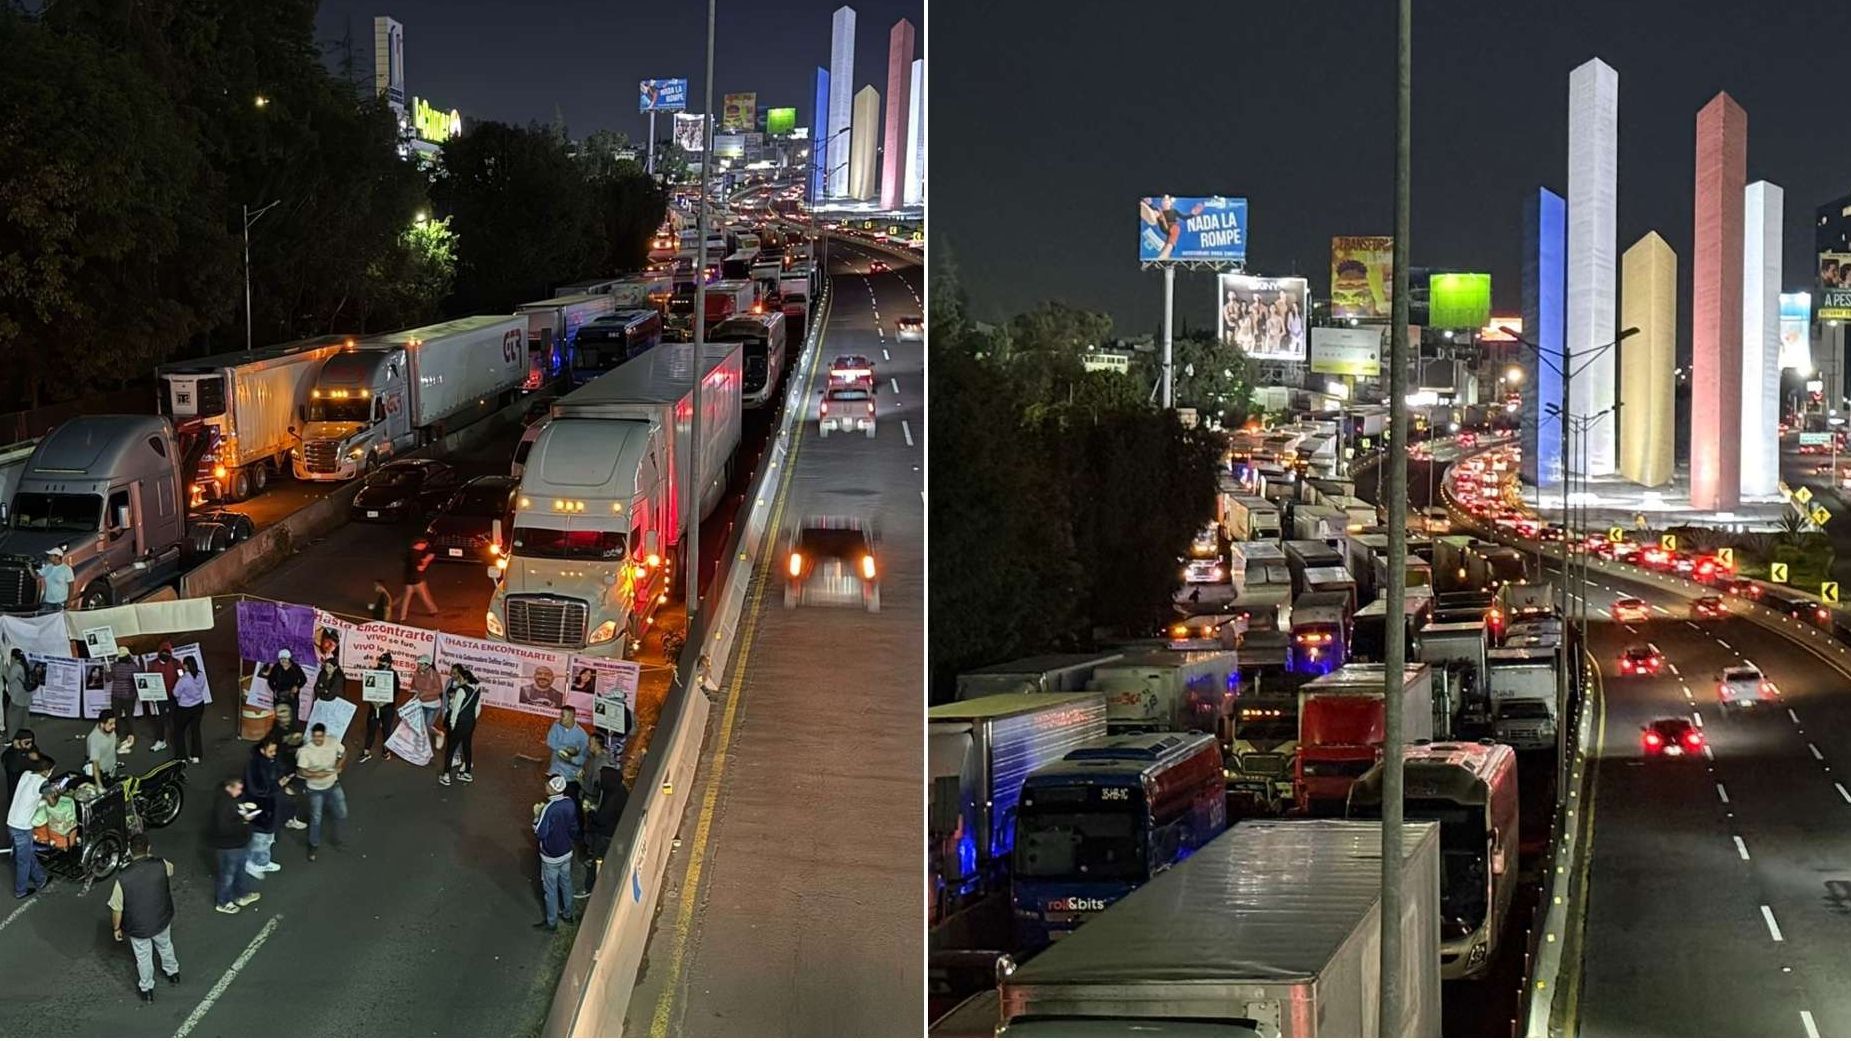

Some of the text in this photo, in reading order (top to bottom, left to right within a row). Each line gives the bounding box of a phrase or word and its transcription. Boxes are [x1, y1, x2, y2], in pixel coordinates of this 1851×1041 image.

[1187, 211, 1238, 232] NADA LA
[1200, 229, 1242, 248] ROMPE
[1825, 293, 1832, 307] A
[313, 610, 435, 643] Hasta Encontrarte
[353, 643, 375, 651] VIVO
[366, 634, 388, 642] VIVO
[481, 643, 556, 662] ENCONTRARTE!
